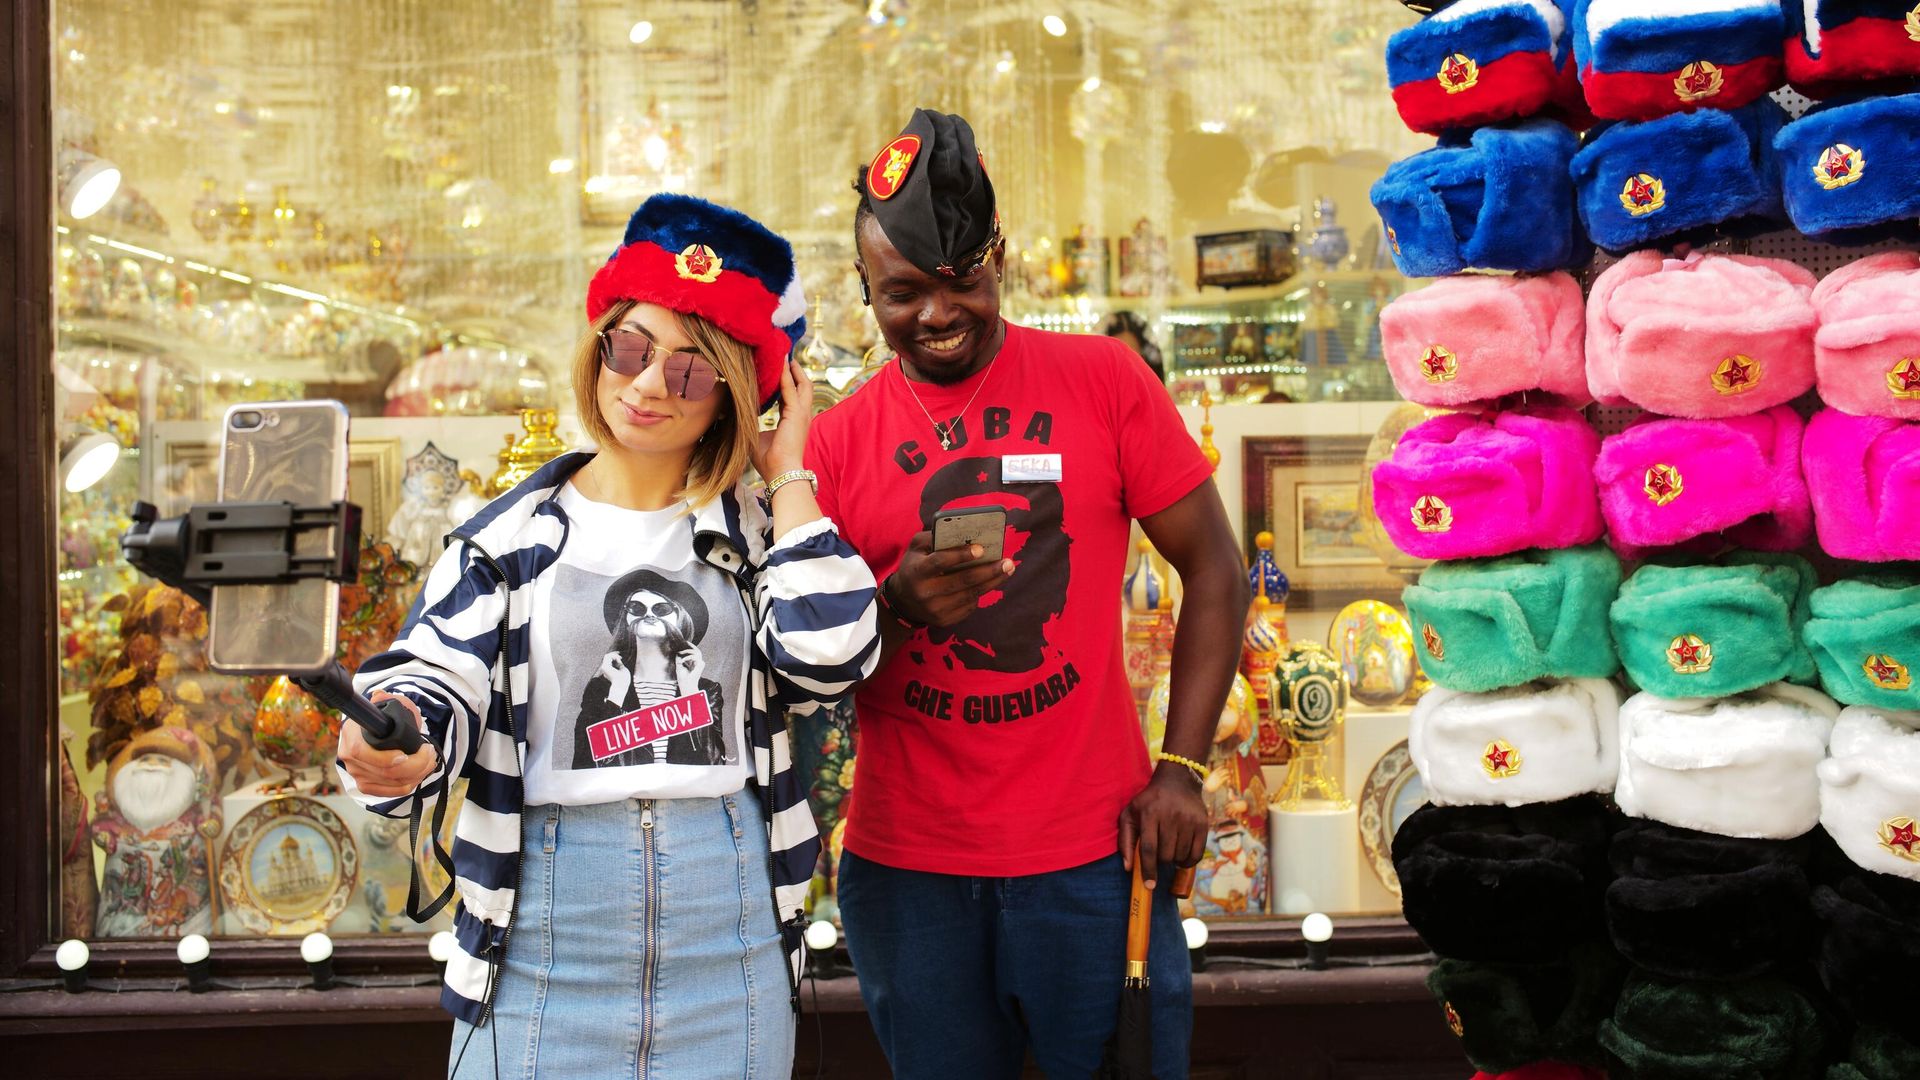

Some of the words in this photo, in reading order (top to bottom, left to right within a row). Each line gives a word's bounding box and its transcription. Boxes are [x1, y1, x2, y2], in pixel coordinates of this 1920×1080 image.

[893, 407, 1053, 475] CUBA
[904, 680, 954, 720] CHE
[963, 662, 1081, 724] GUEVARA
[603, 716, 645, 751] LIVE
[651, 700, 693, 734] NOW
